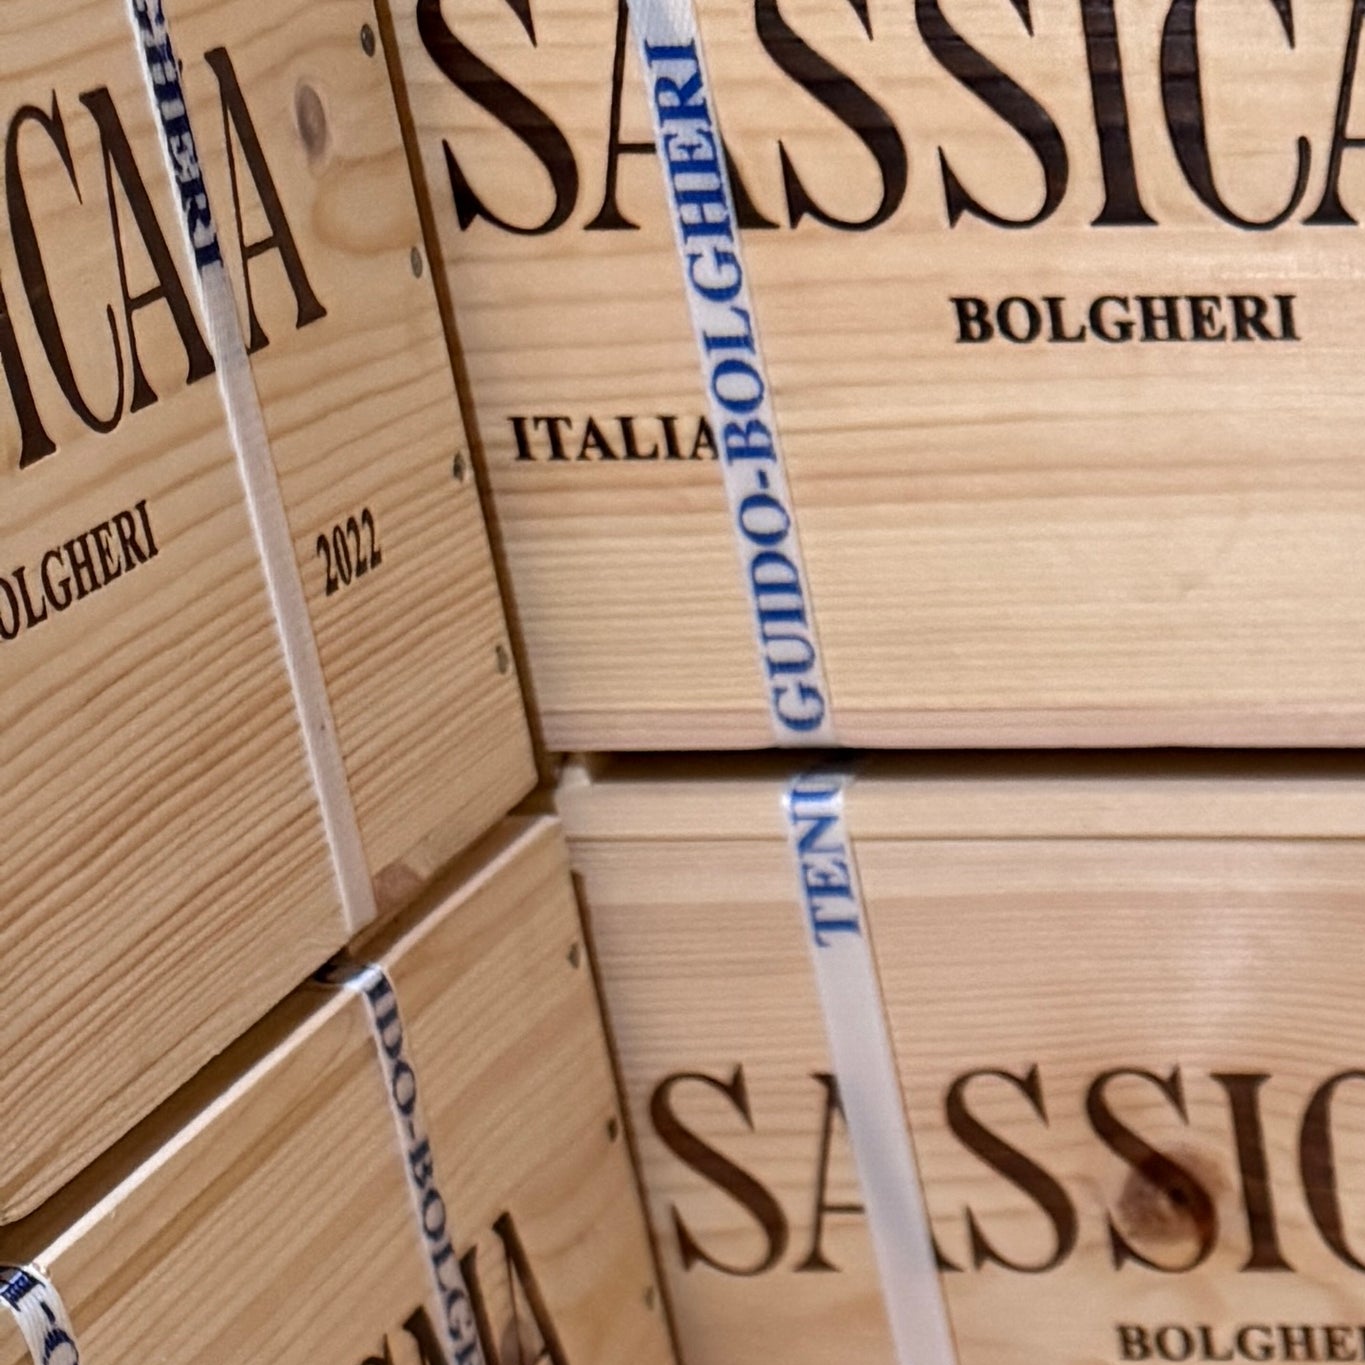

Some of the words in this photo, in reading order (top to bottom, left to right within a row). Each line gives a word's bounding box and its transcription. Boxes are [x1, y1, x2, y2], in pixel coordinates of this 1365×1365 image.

[950, 294, 1302, 345] BOLGHERI
[644, 37, 826, 733] GUIDO-BOLGHERI
[507, 415, 721, 463] ITALIA
[316, 506, 384, 597] 2022
